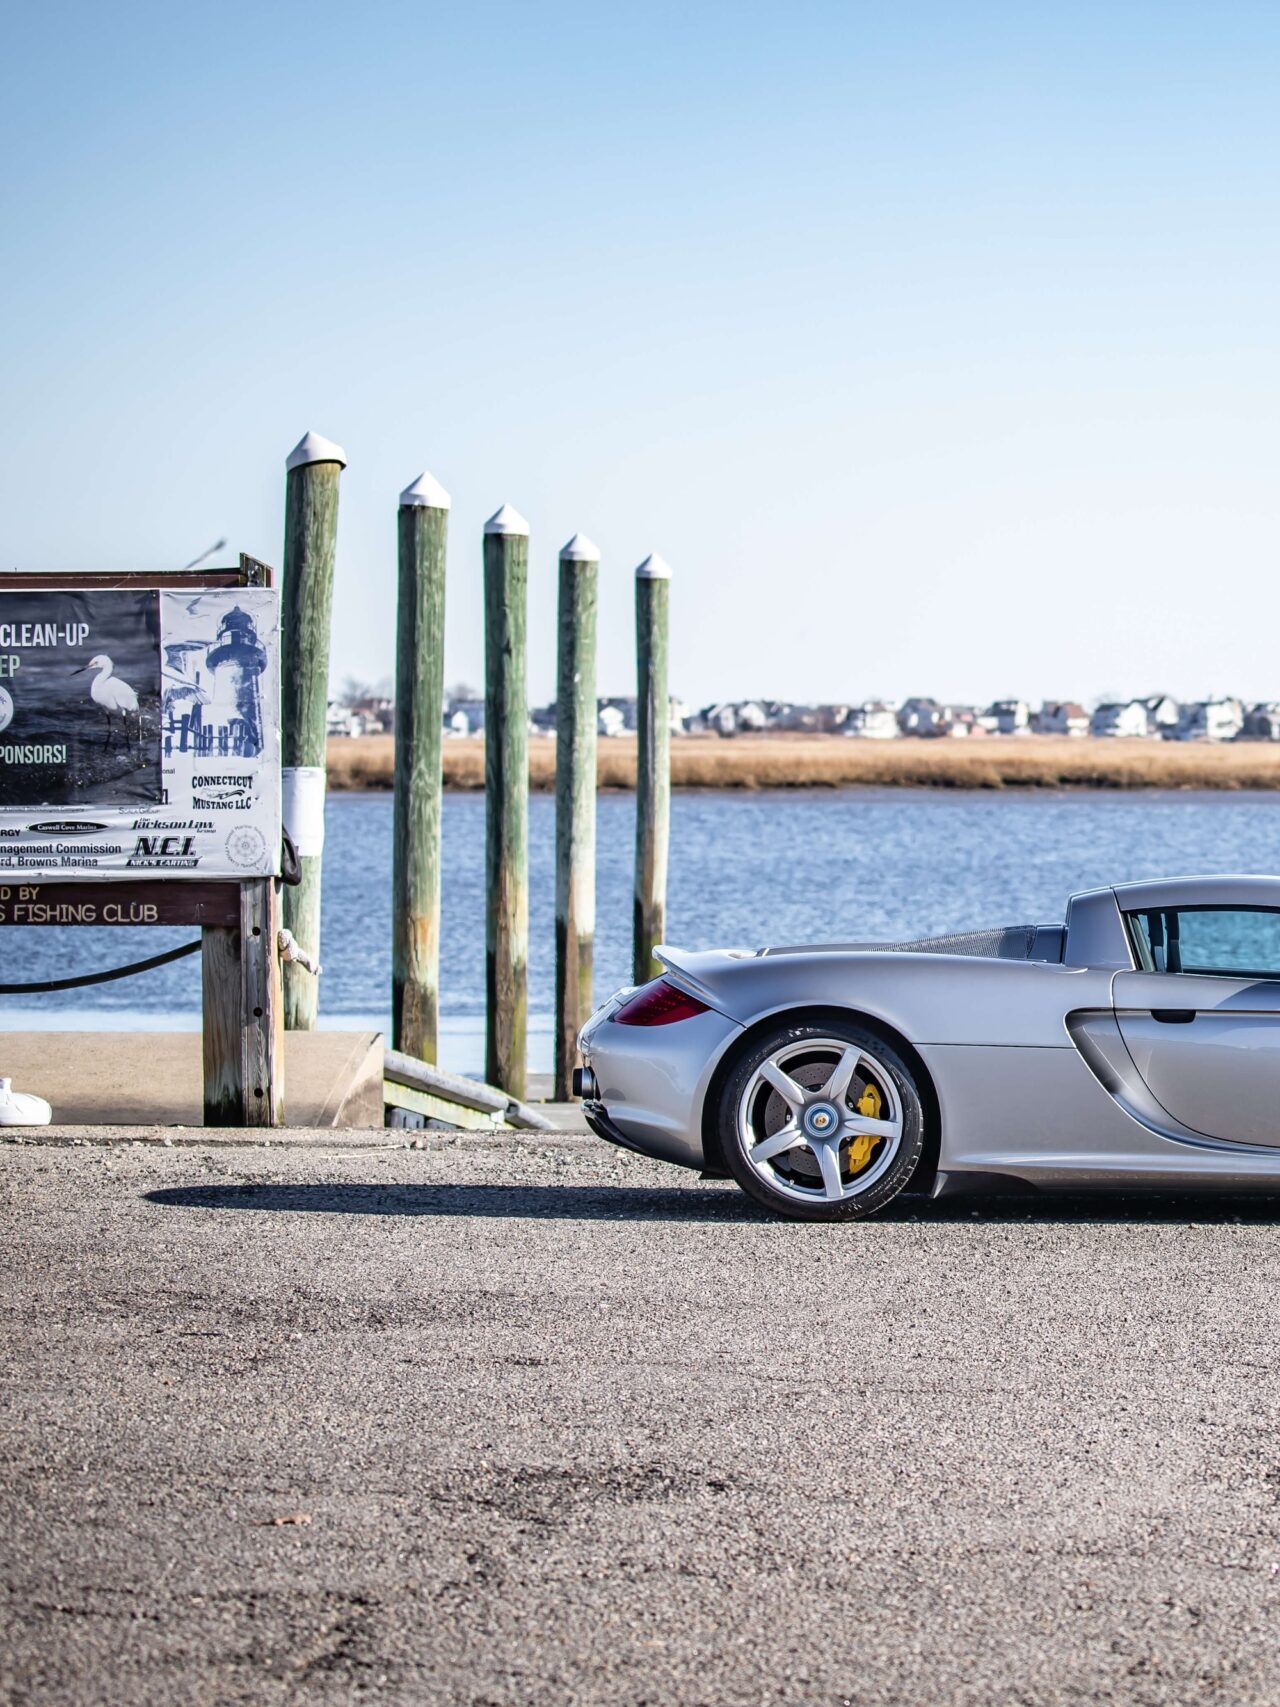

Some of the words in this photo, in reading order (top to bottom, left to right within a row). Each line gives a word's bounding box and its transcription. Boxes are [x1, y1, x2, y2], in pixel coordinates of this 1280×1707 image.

[0, 623, 90, 647] CLEAN-UP
[192, 775, 253, 789] CONNECTICUT
[193, 796, 234, 810] MUSTANG
[235, 796, 252, 810] LLC
[131, 819, 187, 830] Jackson
[188, 819, 216, 829] Law
[56, 843, 122, 854] Commission
[17, 856, 58, 868] Browns
[61, 856, 98, 868] Marina
[19, 887, 40, 900] BY
[14, 904, 97, 922] FISHING
[103, 904, 158, 922] CLUB
